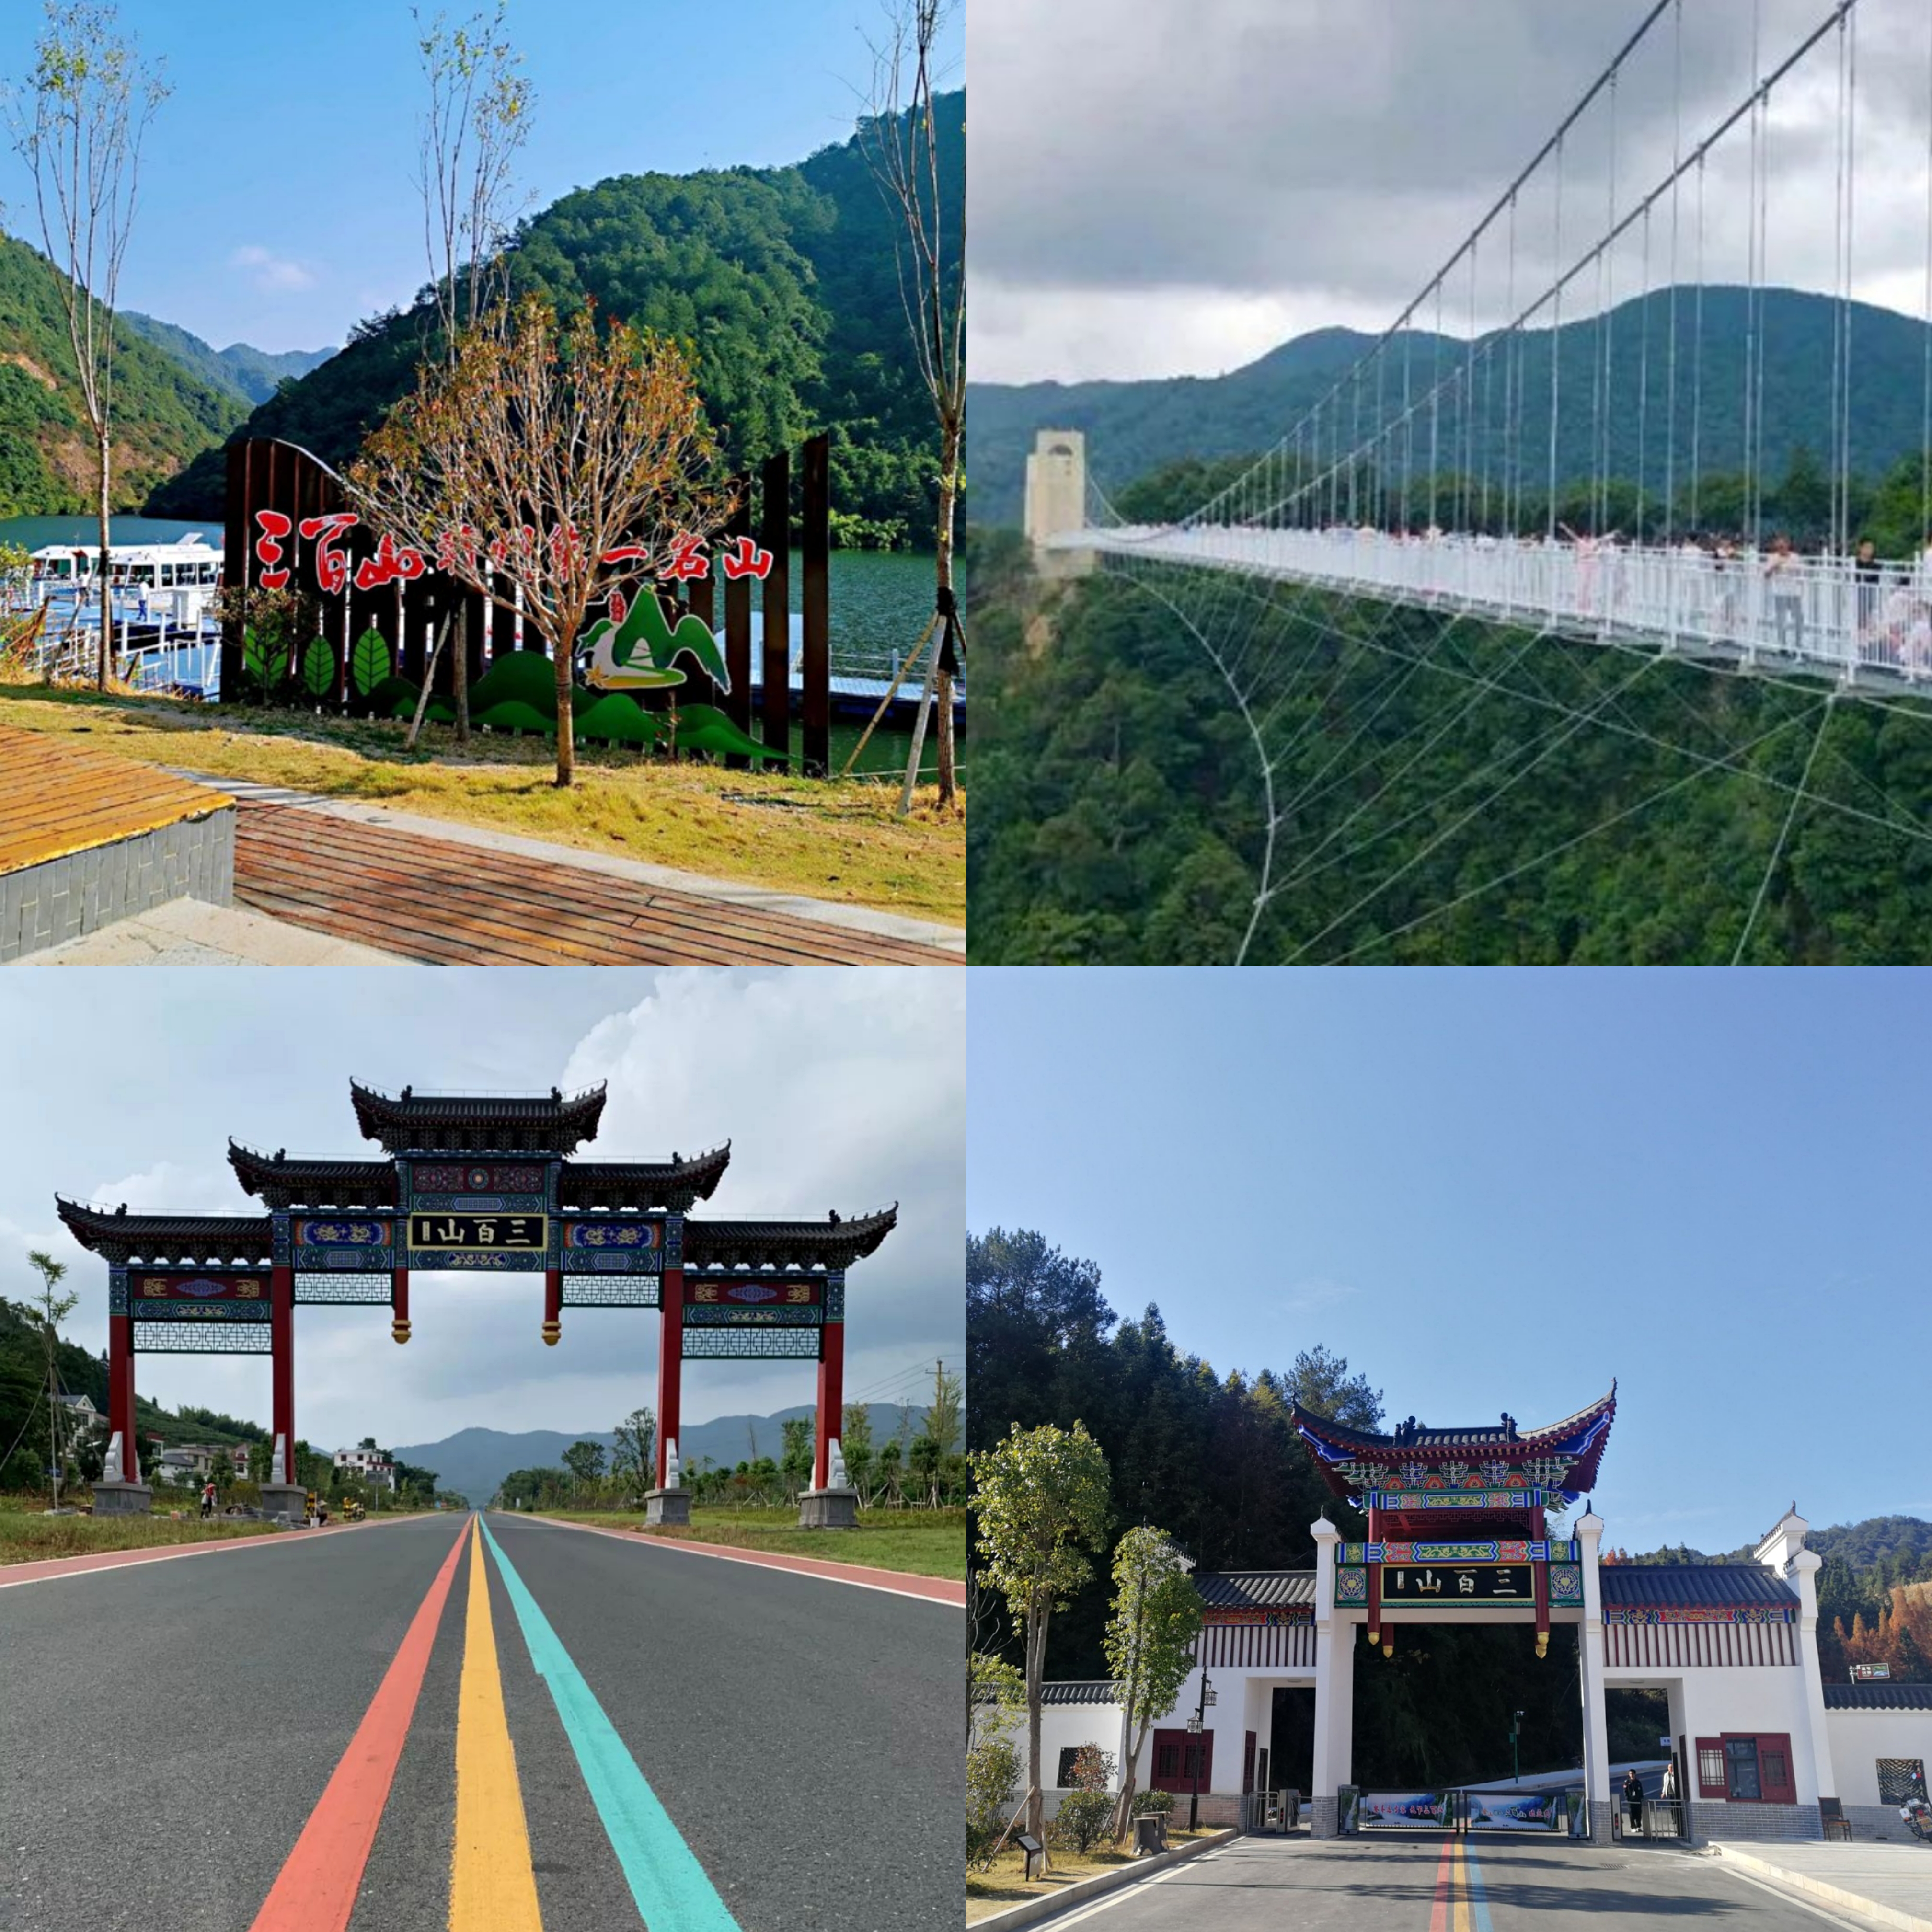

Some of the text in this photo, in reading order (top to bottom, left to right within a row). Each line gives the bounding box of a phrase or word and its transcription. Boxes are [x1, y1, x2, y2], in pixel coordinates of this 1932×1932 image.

[437, 1219, 530, 1244] 三百山
[1415, 1569, 1518, 1594] 三百山
